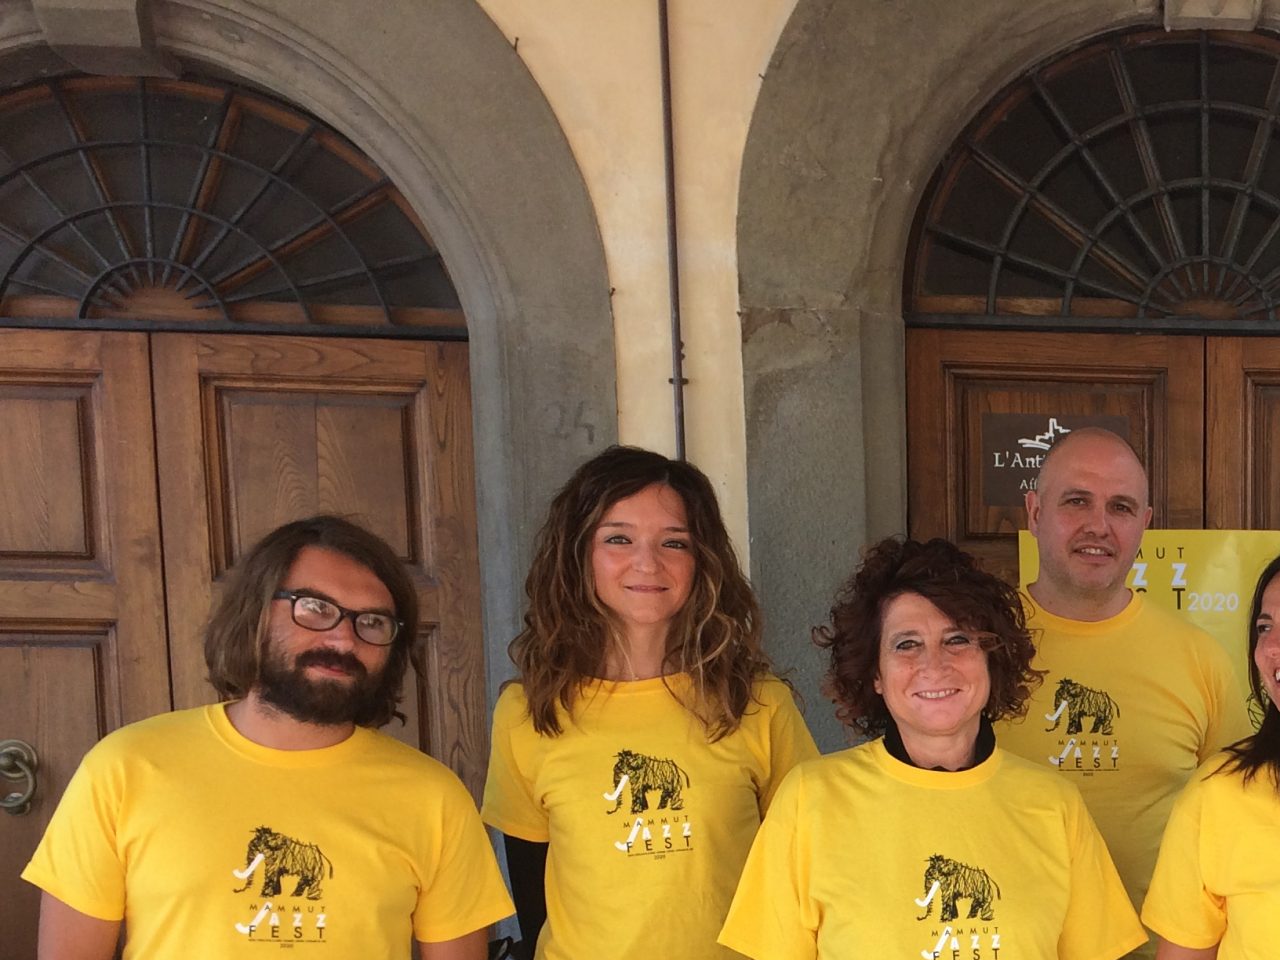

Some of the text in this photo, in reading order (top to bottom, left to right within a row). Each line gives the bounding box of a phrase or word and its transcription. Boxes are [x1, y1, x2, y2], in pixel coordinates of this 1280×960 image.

[993, 451, 1046, 468] L'Ant
[1188, 592, 1240, 612] 2020
[1059, 758, 1118, 768] FEST
[624, 815, 688, 828] MAMMUT
[627, 835, 691, 853] FEST
[250, 904, 326, 913] MAMMUT
[249, 925, 325, 939] FEST
[932, 927, 999, 937] MAMMUT
